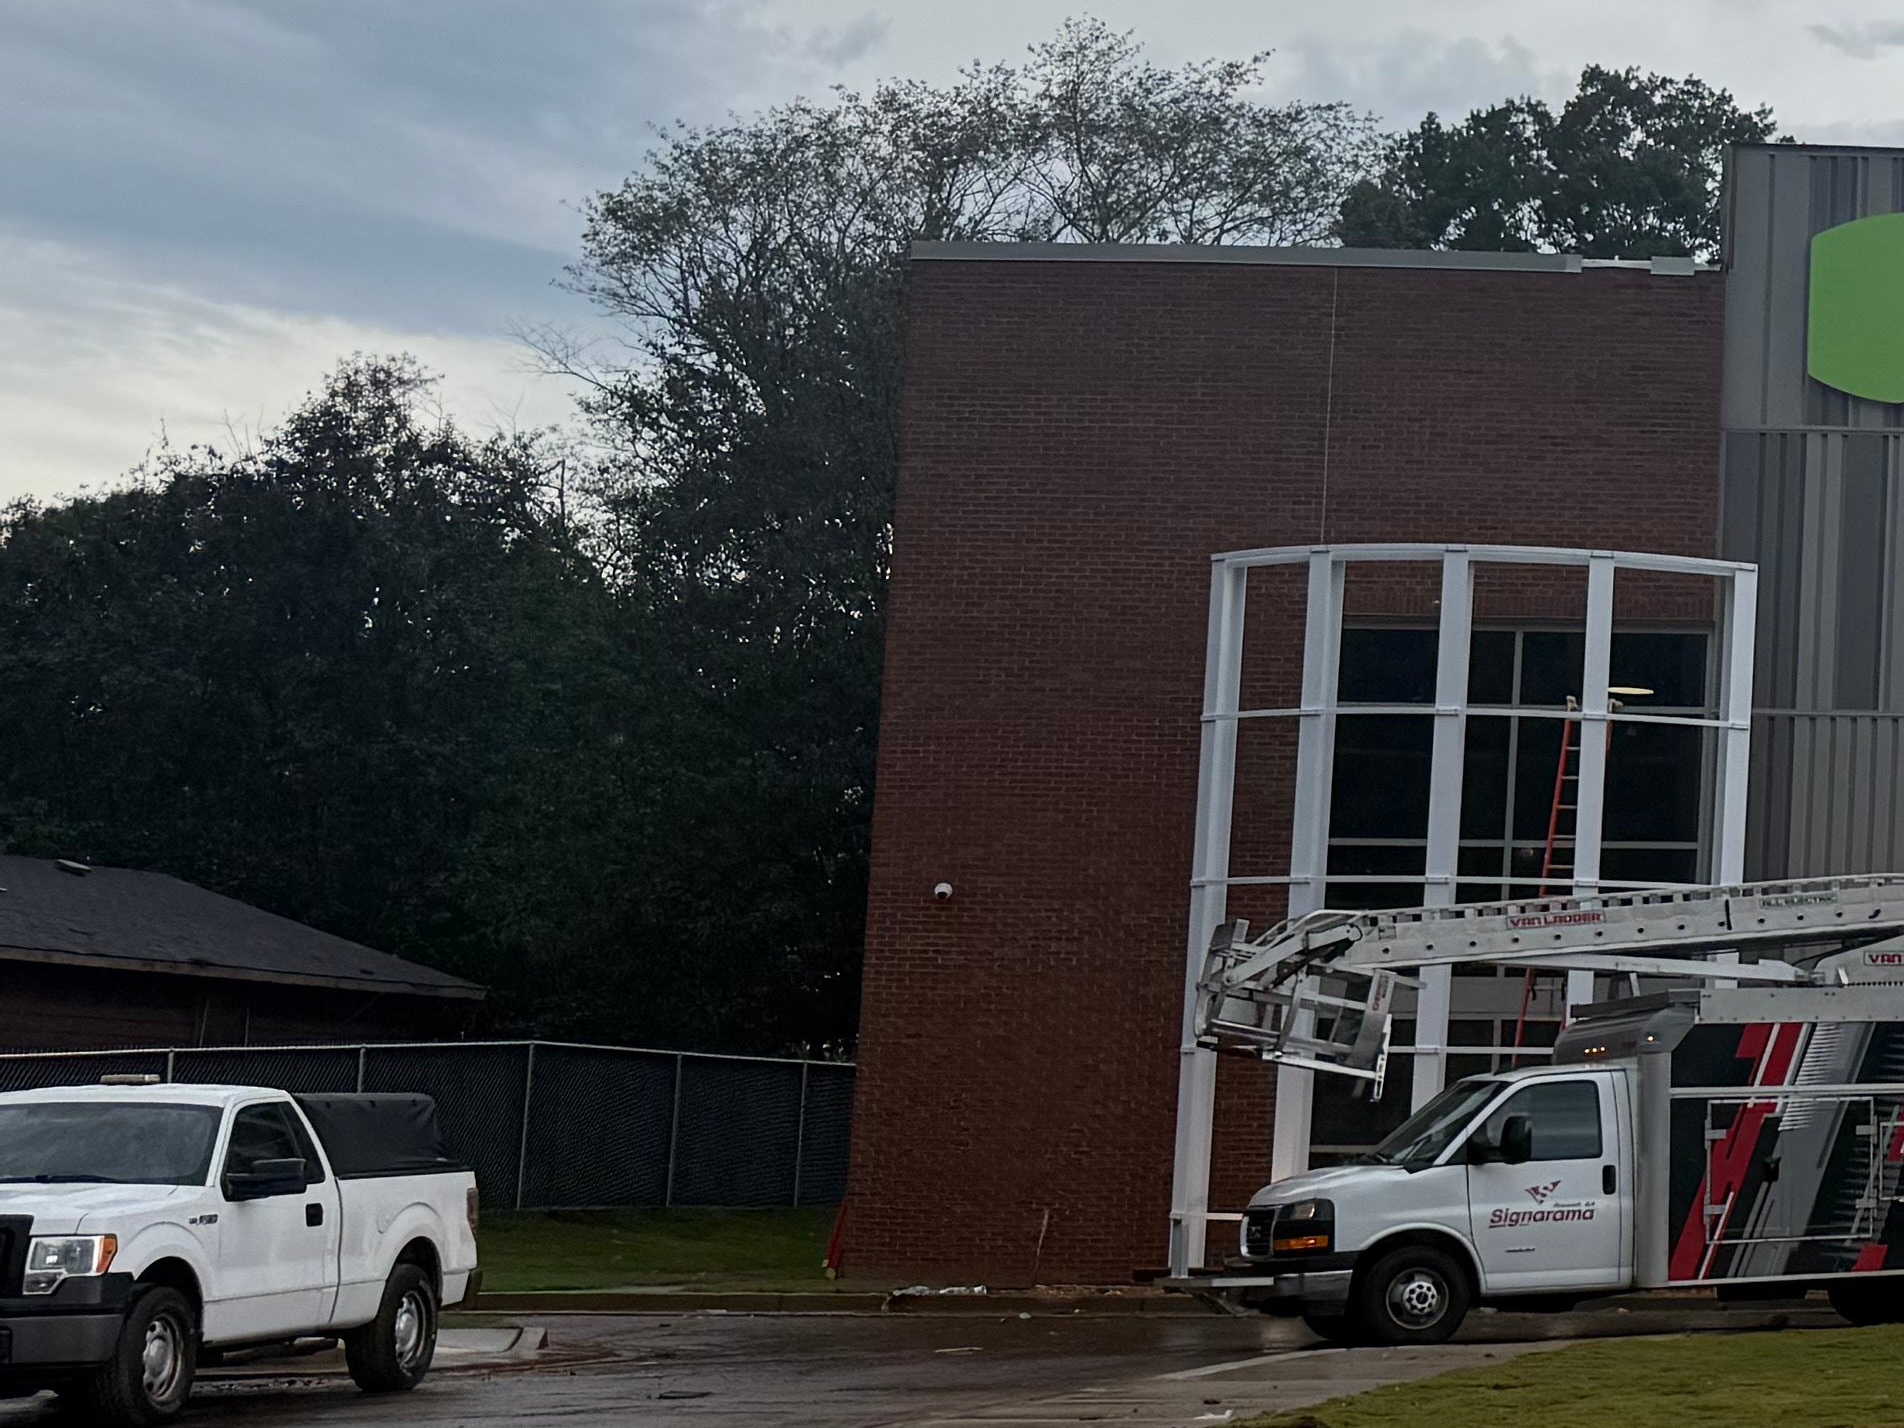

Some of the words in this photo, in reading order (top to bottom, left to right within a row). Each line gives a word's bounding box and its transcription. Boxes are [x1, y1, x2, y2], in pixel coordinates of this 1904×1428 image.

[1510, 916, 1541, 927] VAN
[1544, 913, 1601, 925] LADDER
[1868, 954, 1902, 964] VAN
[1489, 1207, 1596, 1228] Signarama
